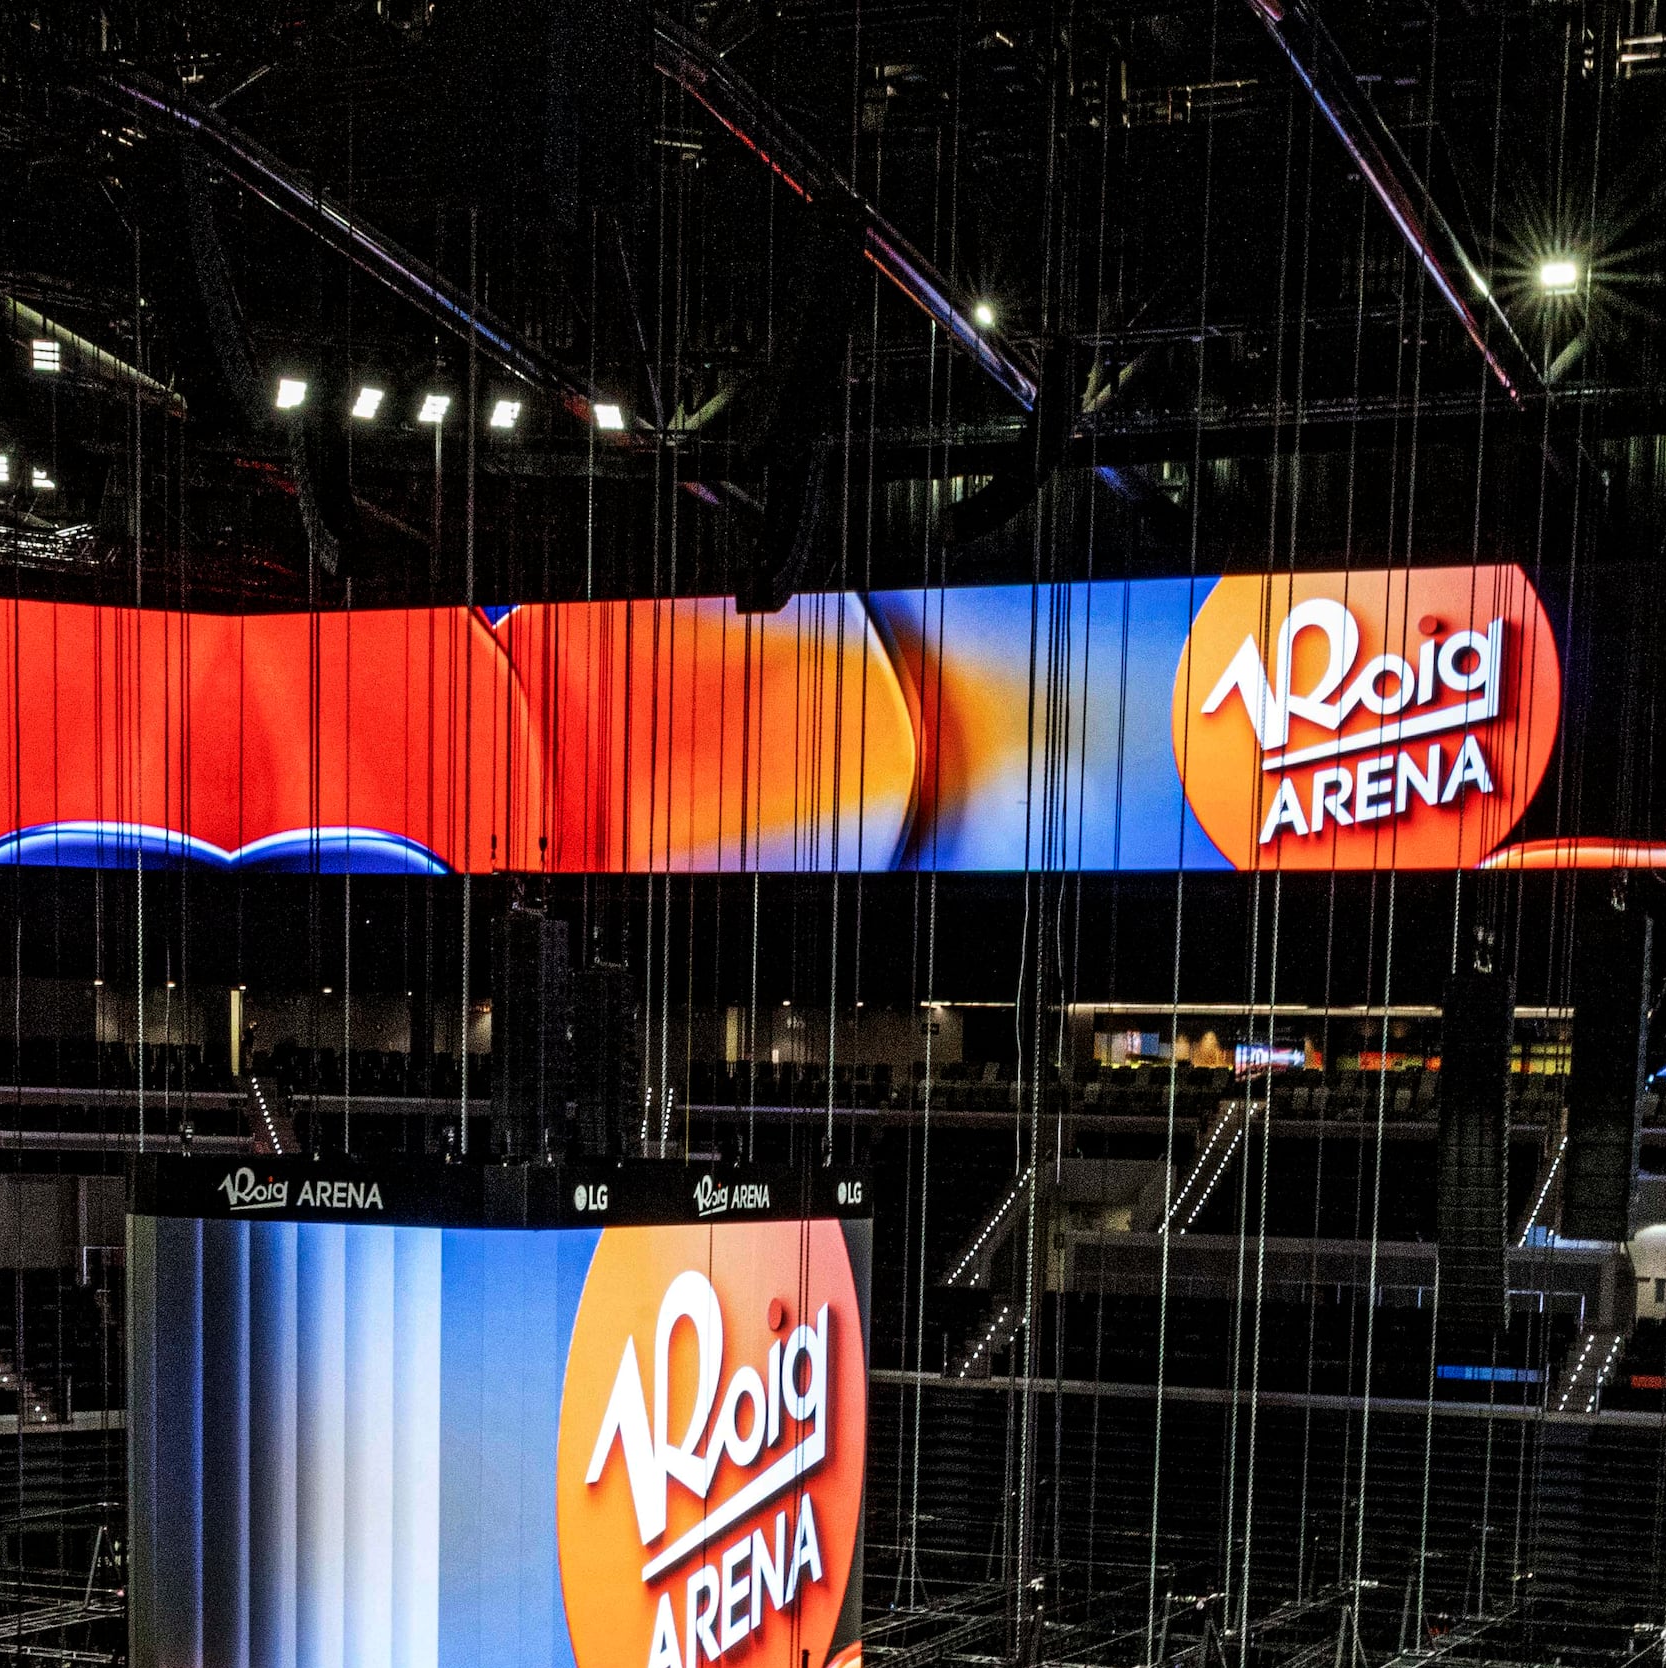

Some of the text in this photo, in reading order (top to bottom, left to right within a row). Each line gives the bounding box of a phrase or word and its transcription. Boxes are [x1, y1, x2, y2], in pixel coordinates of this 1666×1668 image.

[1201, 598, 1504, 771] Roig
[1259, 734, 1494, 845] ARENA
[218, 1167, 384, 1211] Roig ARENA
[588, 1184, 609, 1210] LG
[693, 1174, 770, 1217] Roig ARENA
[847, 1181, 863, 1204] LG
[585, 1270, 829, 1582] Roig
